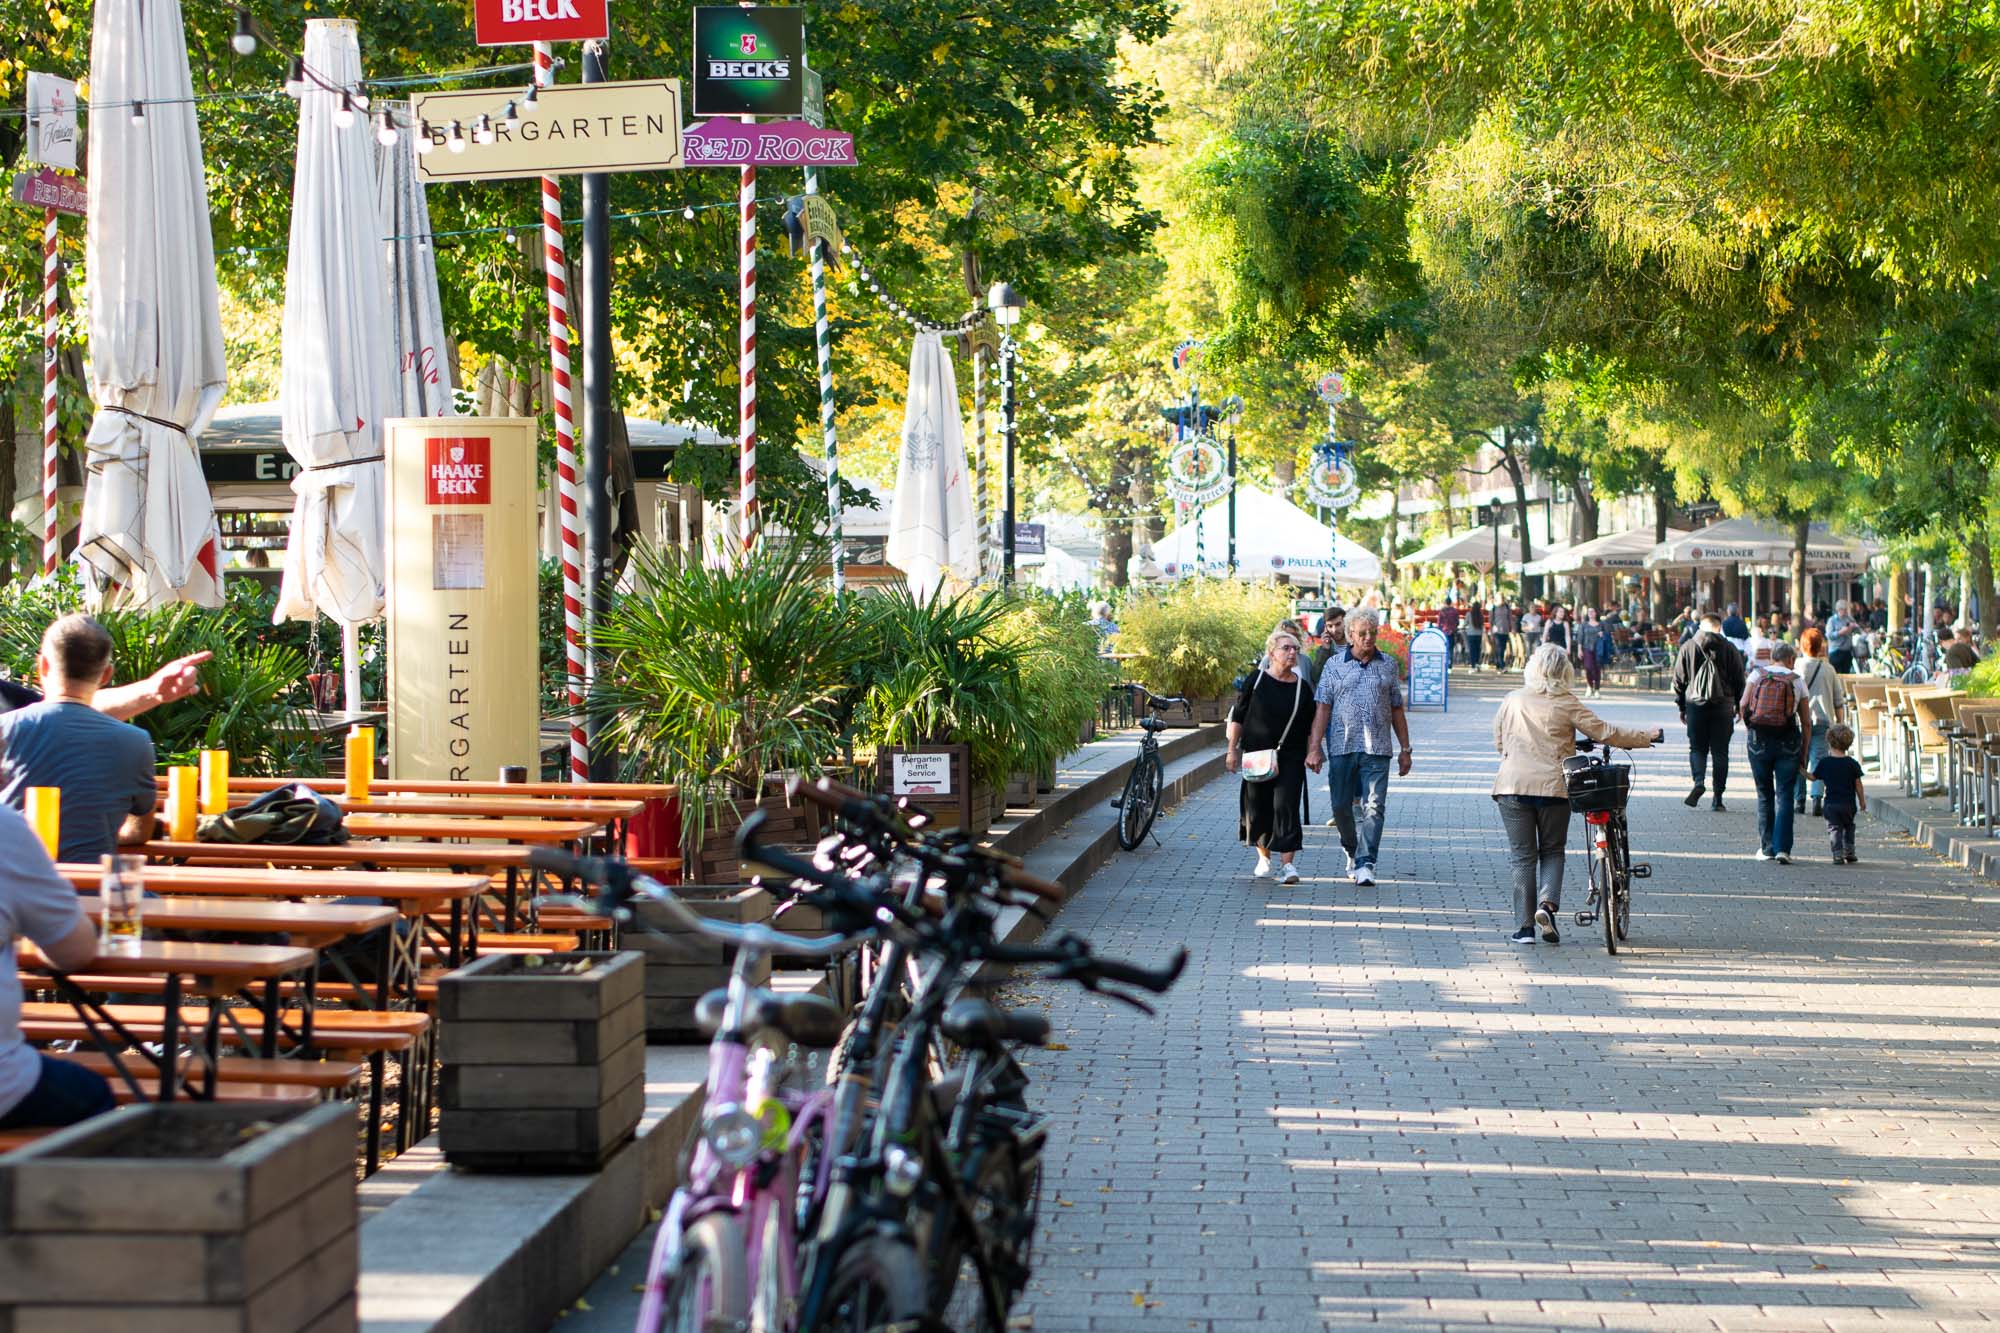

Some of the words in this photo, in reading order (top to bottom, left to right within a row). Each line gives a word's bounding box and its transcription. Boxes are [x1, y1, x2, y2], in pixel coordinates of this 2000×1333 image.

[501, 0, 581, 22] BECK
[709, 60, 790, 78] BECK'S
[432, 113, 664, 146] BERGARTEN
[682, 134, 752, 161] RED
[754, 134, 851, 161] ROCK
[33, 178, 59, 206] RED
[431, 464, 484, 479] HAAKE
[437, 479, 477, 495] BECK
[1705, 549, 1754, 558] PAULANER
[1181, 559, 1241, 572] PALANR
[901, 755, 942, 764] Biergarten
